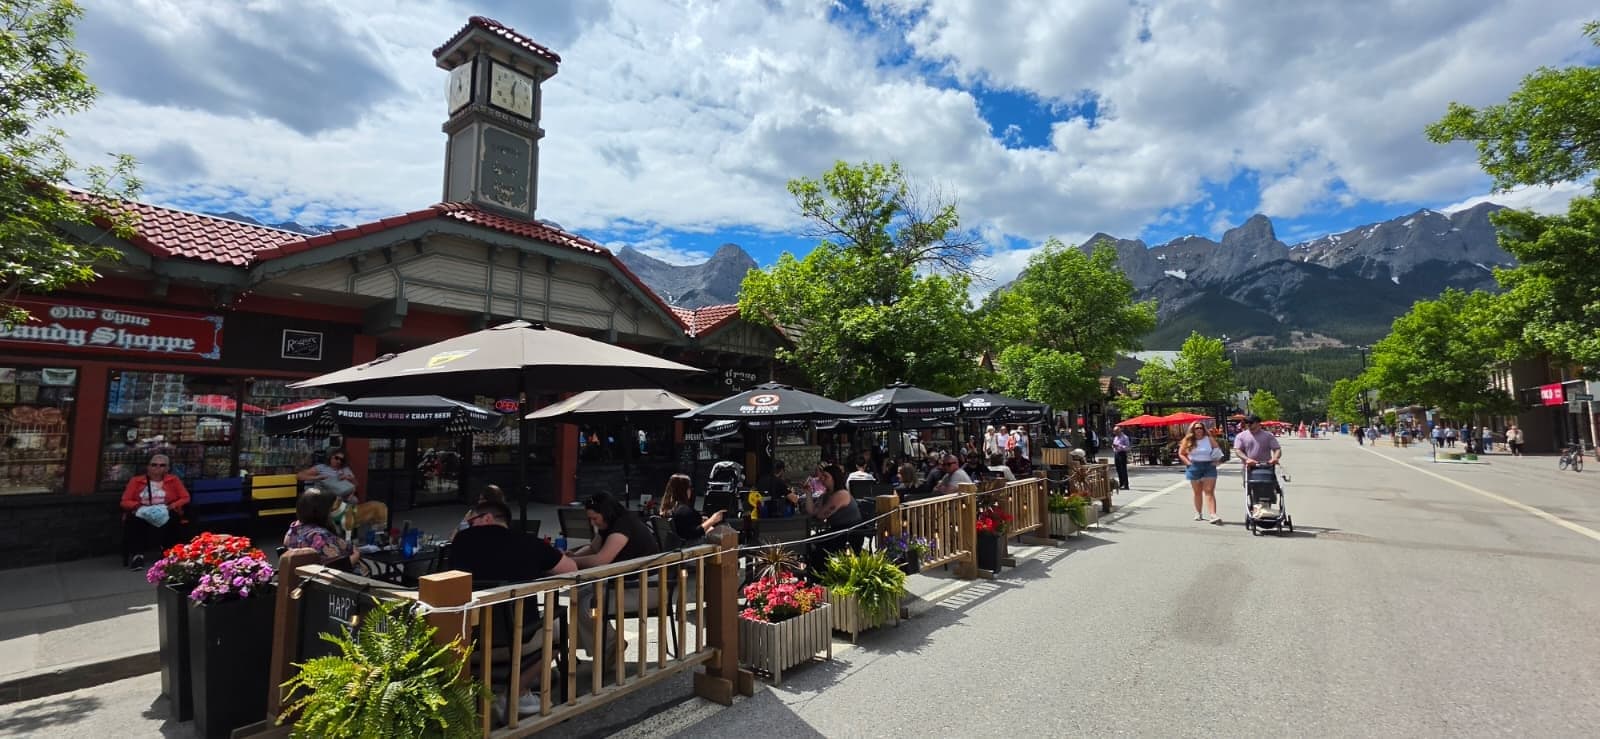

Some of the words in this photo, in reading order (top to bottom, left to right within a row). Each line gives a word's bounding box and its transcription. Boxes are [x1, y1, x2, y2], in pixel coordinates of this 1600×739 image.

[50, 305, 97, 320] Olde
[101, 308, 151, 327] Tyme
[89, 326, 196, 352] Shoppe
[338, 409, 364, 419] PROUD
[411, 412, 433, 420] CRAFT
[434, 411, 452, 419] BEER
[495, 400, 519, 412] OPEN
